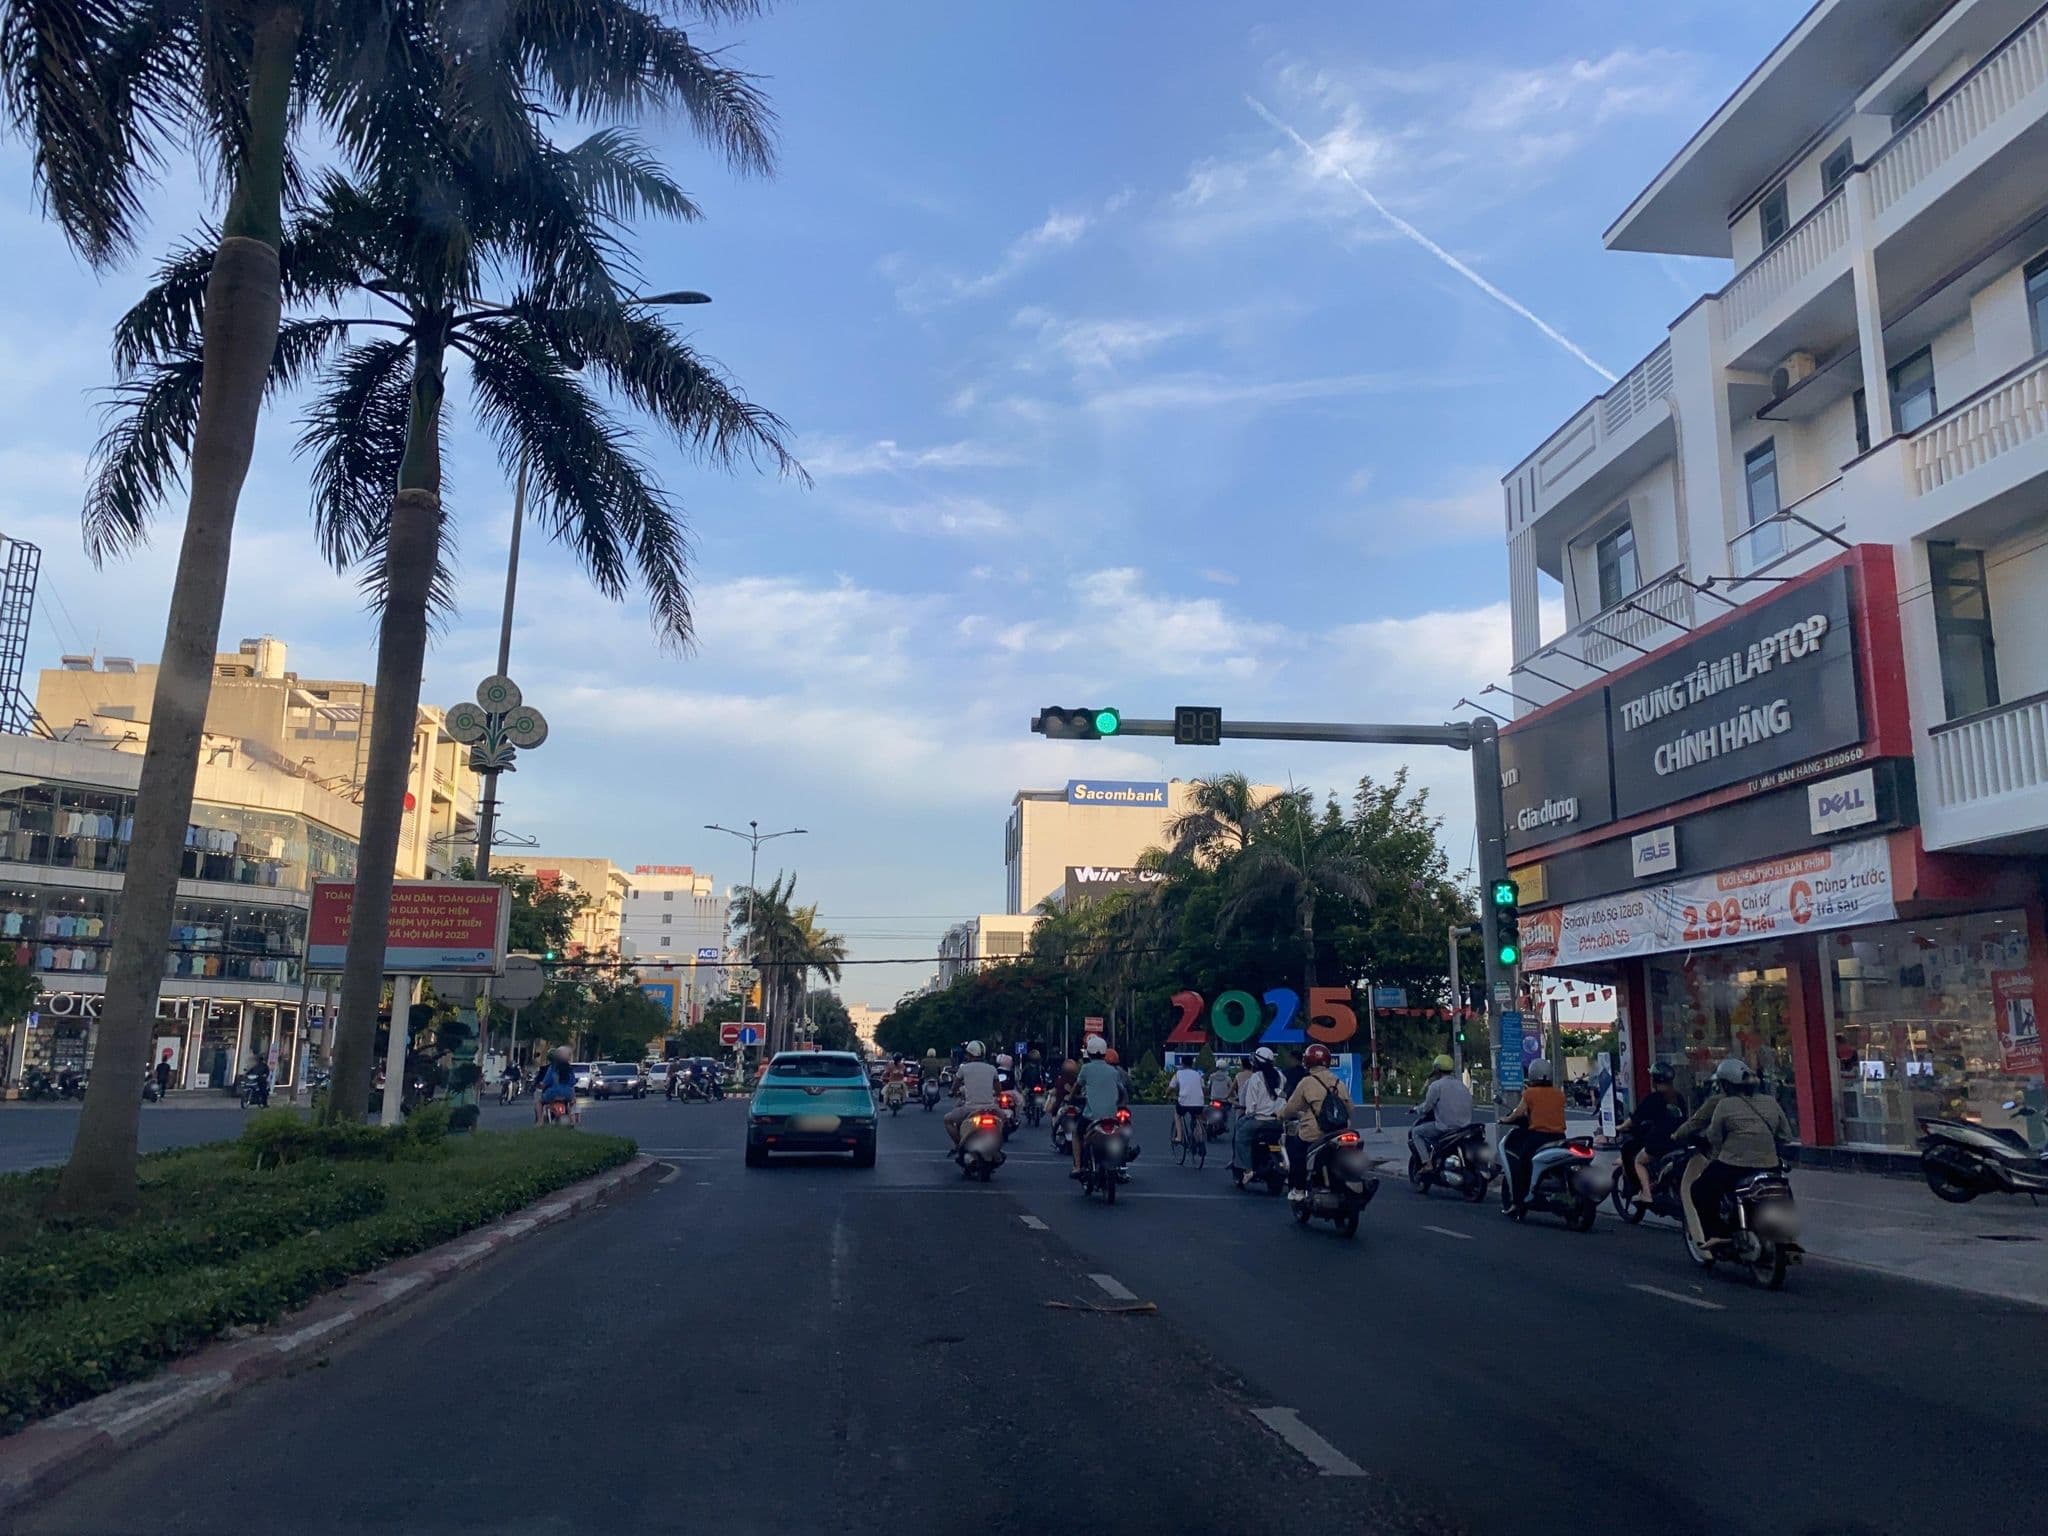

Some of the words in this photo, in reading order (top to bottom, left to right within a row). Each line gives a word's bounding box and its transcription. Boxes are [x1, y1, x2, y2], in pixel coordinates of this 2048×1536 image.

[1620, 680, 1686, 732] TRUNG
[1684, 657, 1734, 704] TÂM
[1732, 614, 1828, 684] LAPTOP
[1654, 726, 1720, 776] CHÍNH
[1720, 698, 1792, 754] HÃNG
[1074, 785, 1163, 802] Sacombank
[1818, 789, 1865, 816] DELL
[1517, 807, 1540, 831] Gia
[1540, 796, 1578, 827] dụng
[1639, 842, 1671, 863] ASUS
[1850, 868, 1886, 889] trước
[391, 894, 411, 902] OÀN
[1837, 899, 1859, 913] sau
[1563, 914, 1590, 930] Galaxy
[1607, 907, 1618, 921] 5G
[1619, 902, 1644, 919] 128GB
[1683, 897, 1742, 941] 2.99
[699, 950, 718, 959] ACB
[1166, 987, 1357, 1044] 2025
